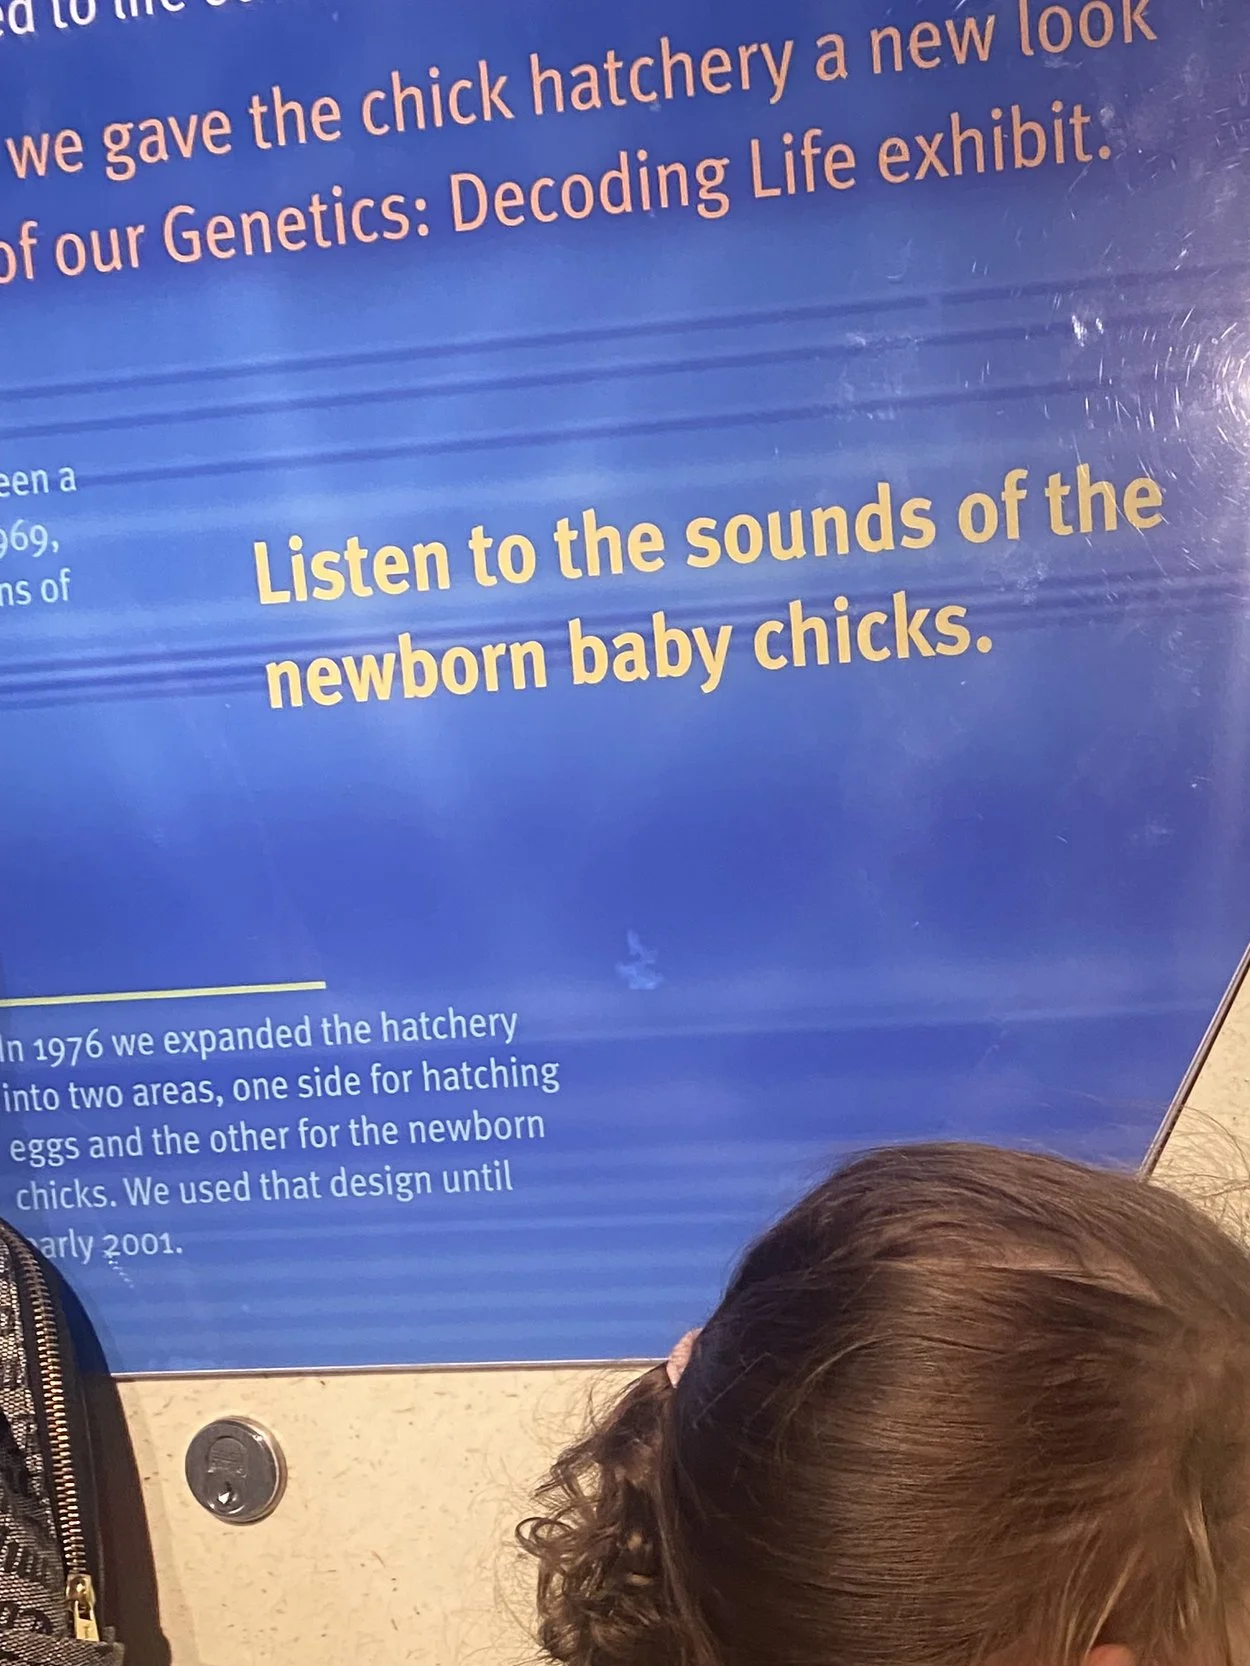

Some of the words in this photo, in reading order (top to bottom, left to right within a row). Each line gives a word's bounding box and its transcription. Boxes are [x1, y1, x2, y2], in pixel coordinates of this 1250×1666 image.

[5, 129, 83, 179] we
[103, 110, 232, 181] gave
[248, 85, 341, 150] the
[362, 59, 515, 136] chick
[530, 36, 794, 115] hatchery
[816, 34, 848, 81] a
[871, 15, 995, 74] new
[1019, 0, 1157, 56] look
[0, 221, 38, 284] of
[55, 224, 145, 276] our
[163, 185, 429, 263] Genetics:
[450, 149, 730, 232] Decoding
[751, 128, 856, 198] Life
[879, 100, 1113, 183] exhibit.
[58, 467, 76, 492] a
[254, 535, 450, 604] Listen
[468, 525, 536, 588] to
[553, 508, 665, 579] the
[686, 482, 936, 568] sounds
[958, 469, 1028, 543] of
[1045, 464, 1163, 534] the
[41, 568, 70, 603] of
[266, 630, 547, 709] newborn
[568, 611, 733, 693] baby
[754, 590, 992, 670] chicks.
[0, 1035, 24, 1062] In
[33, 1028, 103, 1067] 1976
[112, 1033, 154, 1056] we
[164, 1015, 312, 1060] expanded
[321, 1013, 371, 1046] the
[381, 1007, 517, 1044] hatchery
[3, 1083, 60, 1112] into
[68, 1082, 123, 1109] two
[133, 1081, 223, 1107] areas,
[233, 1077, 288, 1101] one
[298, 1065, 360, 1098] side
[370, 1063, 412, 1094] for
[422, 1057, 560, 1093] hatching
[10, 1137, 80, 1167] eggs
[88, 1126, 143, 1158] and
[152, 1125, 200, 1155] the
[210, 1121, 289, 1152] other
[298, 1118, 340, 1148] for
[348, 1115, 398, 1146] the
[409, 1109, 544, 1143] newborn
[17, 1178, 117, 1211] chicks.
[122, 1177, 169, 1206] We
[179, 1171, 250, 1204] used
[259, 1170, 322, 1200] that
[331, 1165, 432, 1202] design
[443, 1160, 513, 1193] until
[28, 1228, 94, 1265] arly
[102, 1231, 182, 1257] 2001.
